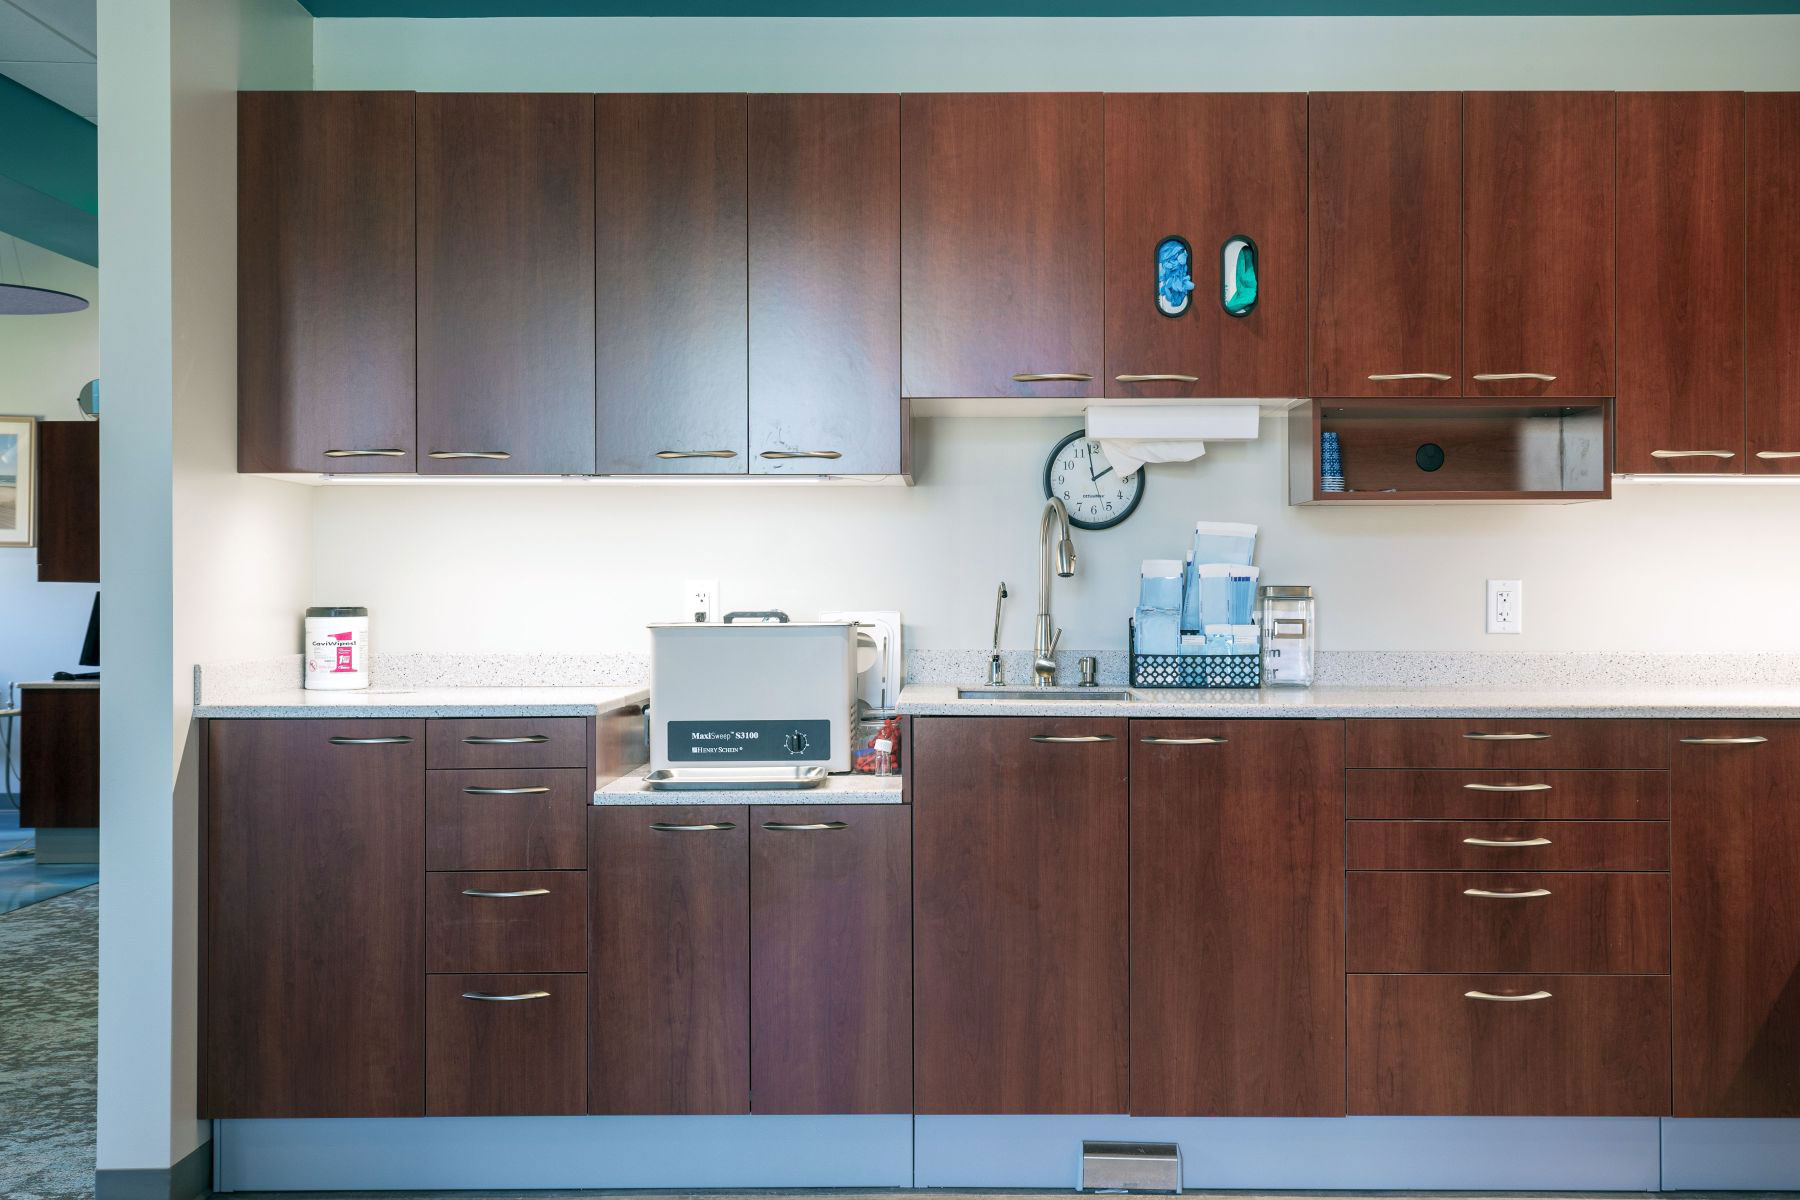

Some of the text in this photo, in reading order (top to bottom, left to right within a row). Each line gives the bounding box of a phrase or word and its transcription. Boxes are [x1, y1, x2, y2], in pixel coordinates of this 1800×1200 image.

[1074, 448, 1084, 458] 11
[1063, 460, 1075, 470] 10
[1058, 475, 1065, 485] 9
[1063, 490, 1071, 500] 8
[1116, 489, 1124, 500] 4
[1076, 502, 1083, 512] 7
[1090, 504, 1098, 515] 6
[1105, 501, 1113, 511] 5
[735, 731, 759, 740] S3100
